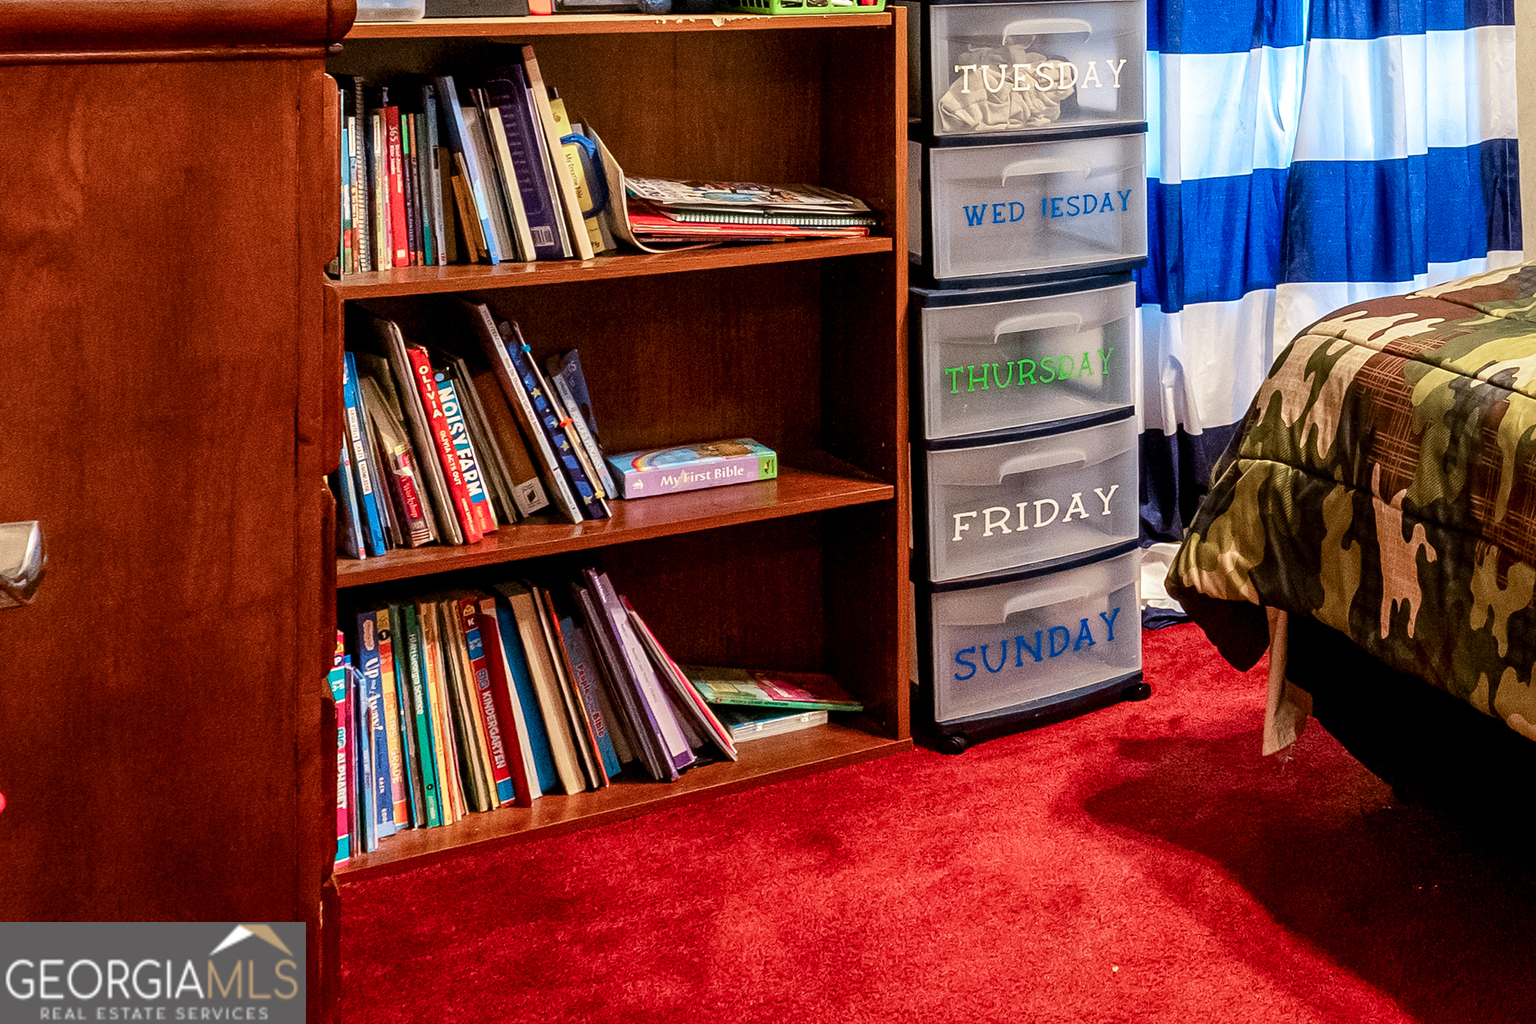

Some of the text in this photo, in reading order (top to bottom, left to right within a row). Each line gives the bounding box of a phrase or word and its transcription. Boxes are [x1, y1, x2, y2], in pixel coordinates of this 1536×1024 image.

[954, 58, 1128, 94] TUESDAY
[418, 364, 443, 419] OLIVIA
[944, 347, 1114, 394] THURSDAY
[438, 386, 469, 448] NOISY
[457, 451, 484, 497] FARM
[439, 429, 462, 486] OLIVIA ACTS OUT
[660, 475, 680, 489] My
[714, 465, 745, 480] Bible
[952, 484, 1120, 542] FRIDAY
[364, 657, 380, 679] Up
[954, 607, 1121, 682] SUNDAY
[384, 691, 397, 712] BIG
[476, 668, 507, 769] BIG KINDERGARTEN
[593, 712, 604, 737] Bible
[390, 748, 402, 784] GRADE
